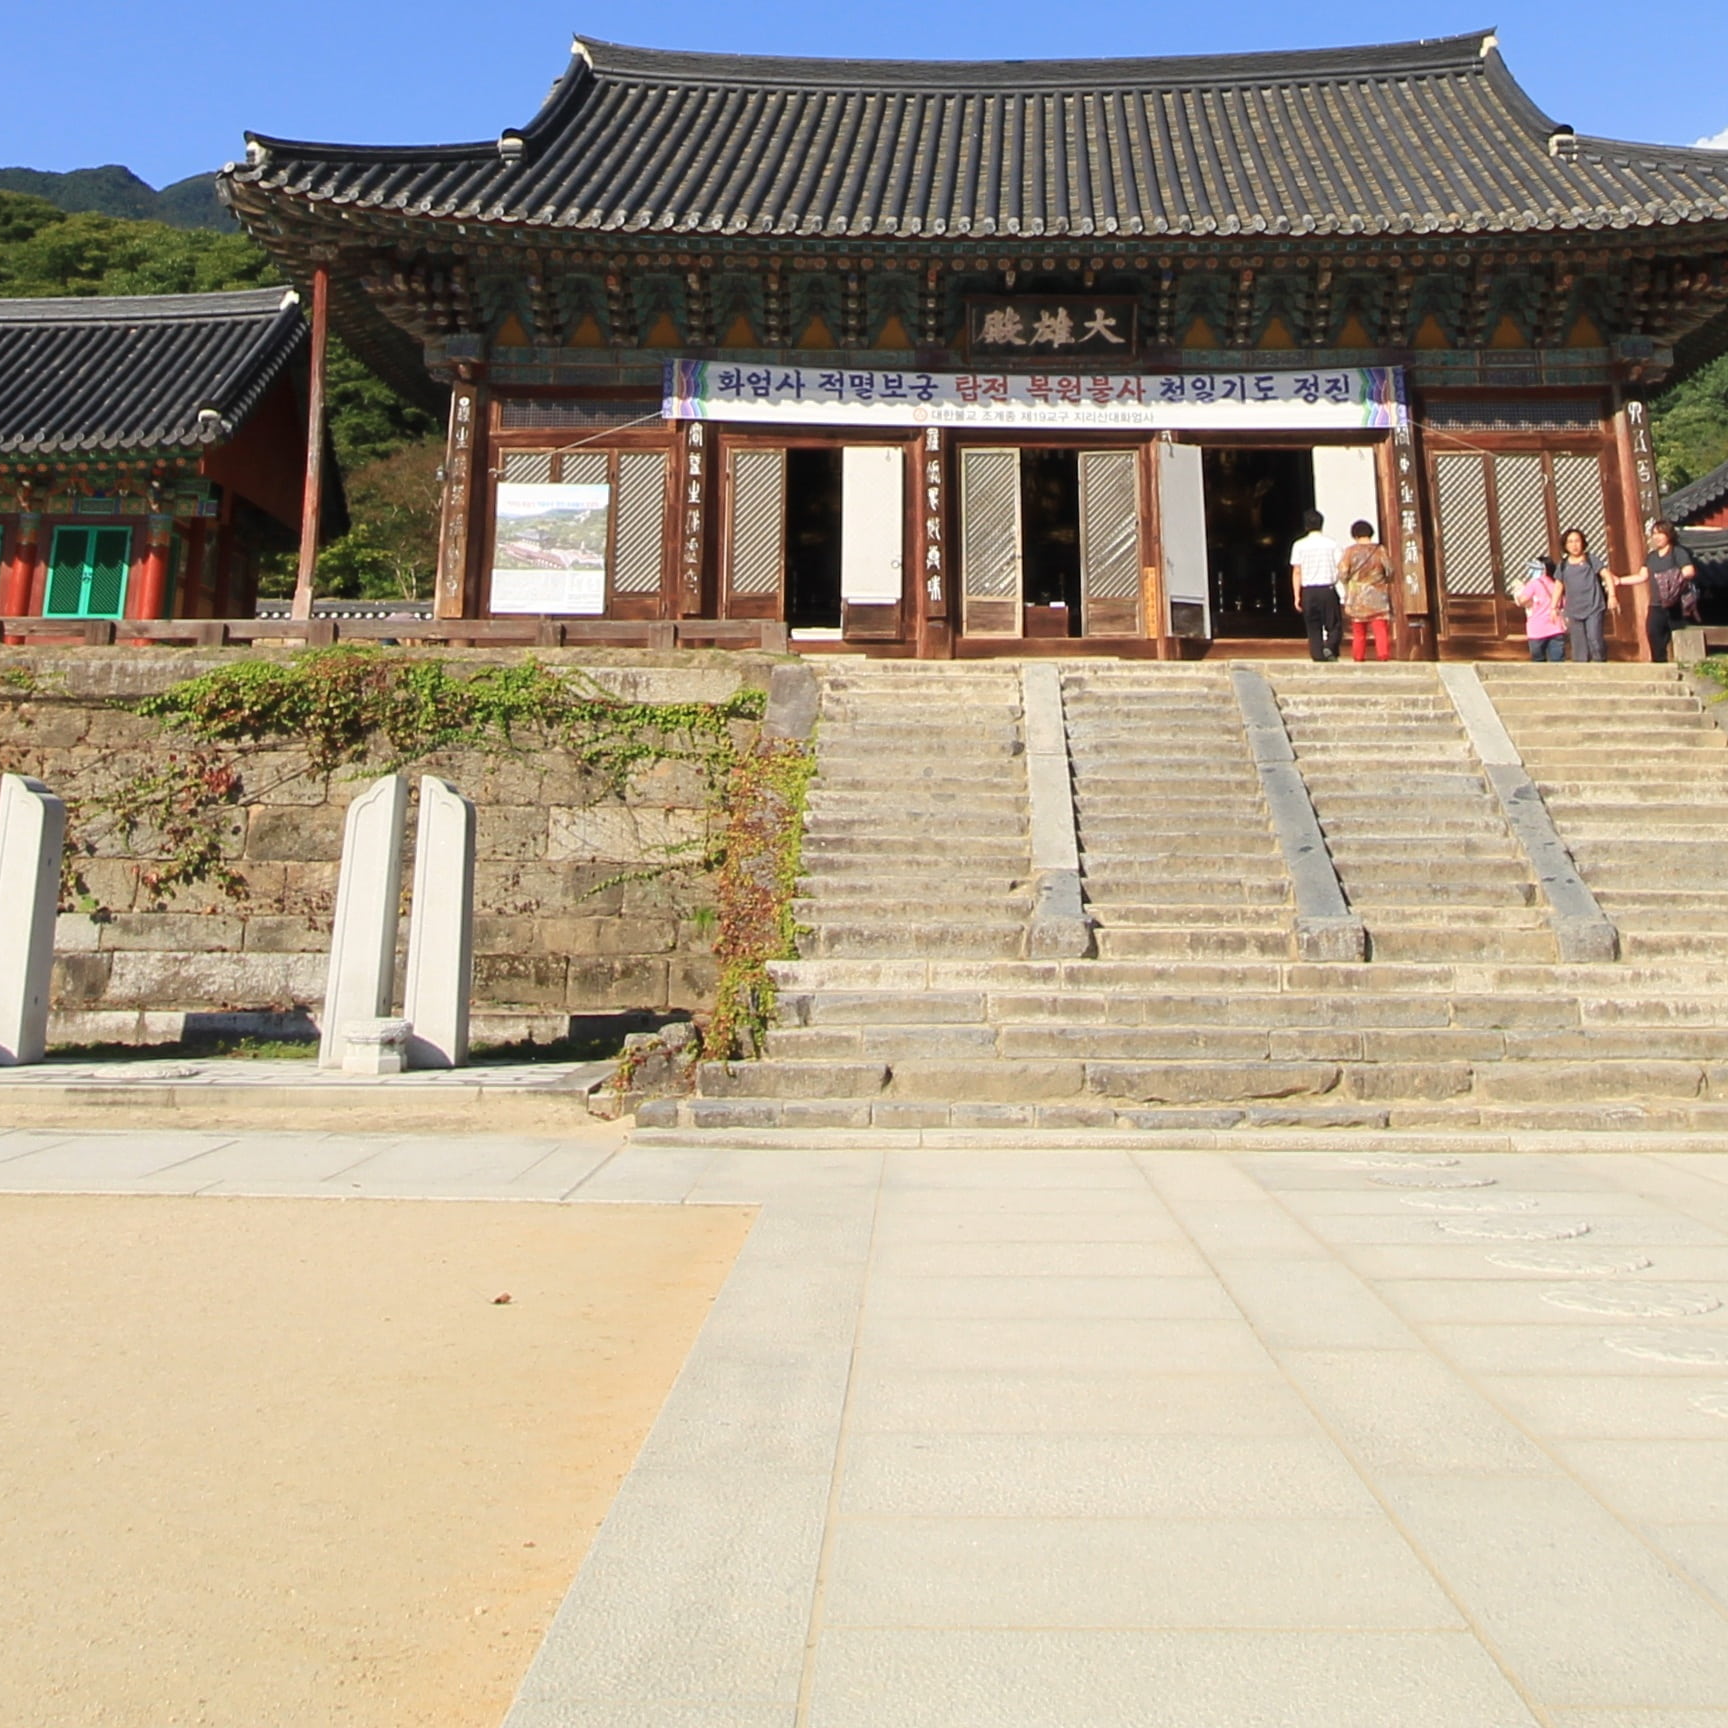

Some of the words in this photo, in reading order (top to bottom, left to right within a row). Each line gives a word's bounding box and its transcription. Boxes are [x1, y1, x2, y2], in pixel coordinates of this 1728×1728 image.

[976, 305, 1126, 349] 大雄殿
[718, 367, 805, 400] 화엄사
[818, 370, 939, 402] 적멸보궁
[955, 374, 1010, 403] 탑전
[1026, 374, 1147, 405] 복원불사
[1159, 374, 1278, 403] 천일기도
[1293, 373, 1350, 403] 정진
[931, 409, 977, 422] 대한불교
[982, 410, 1016, 422] 조계종
[1021, 410, 1069, 423] 제19교구
